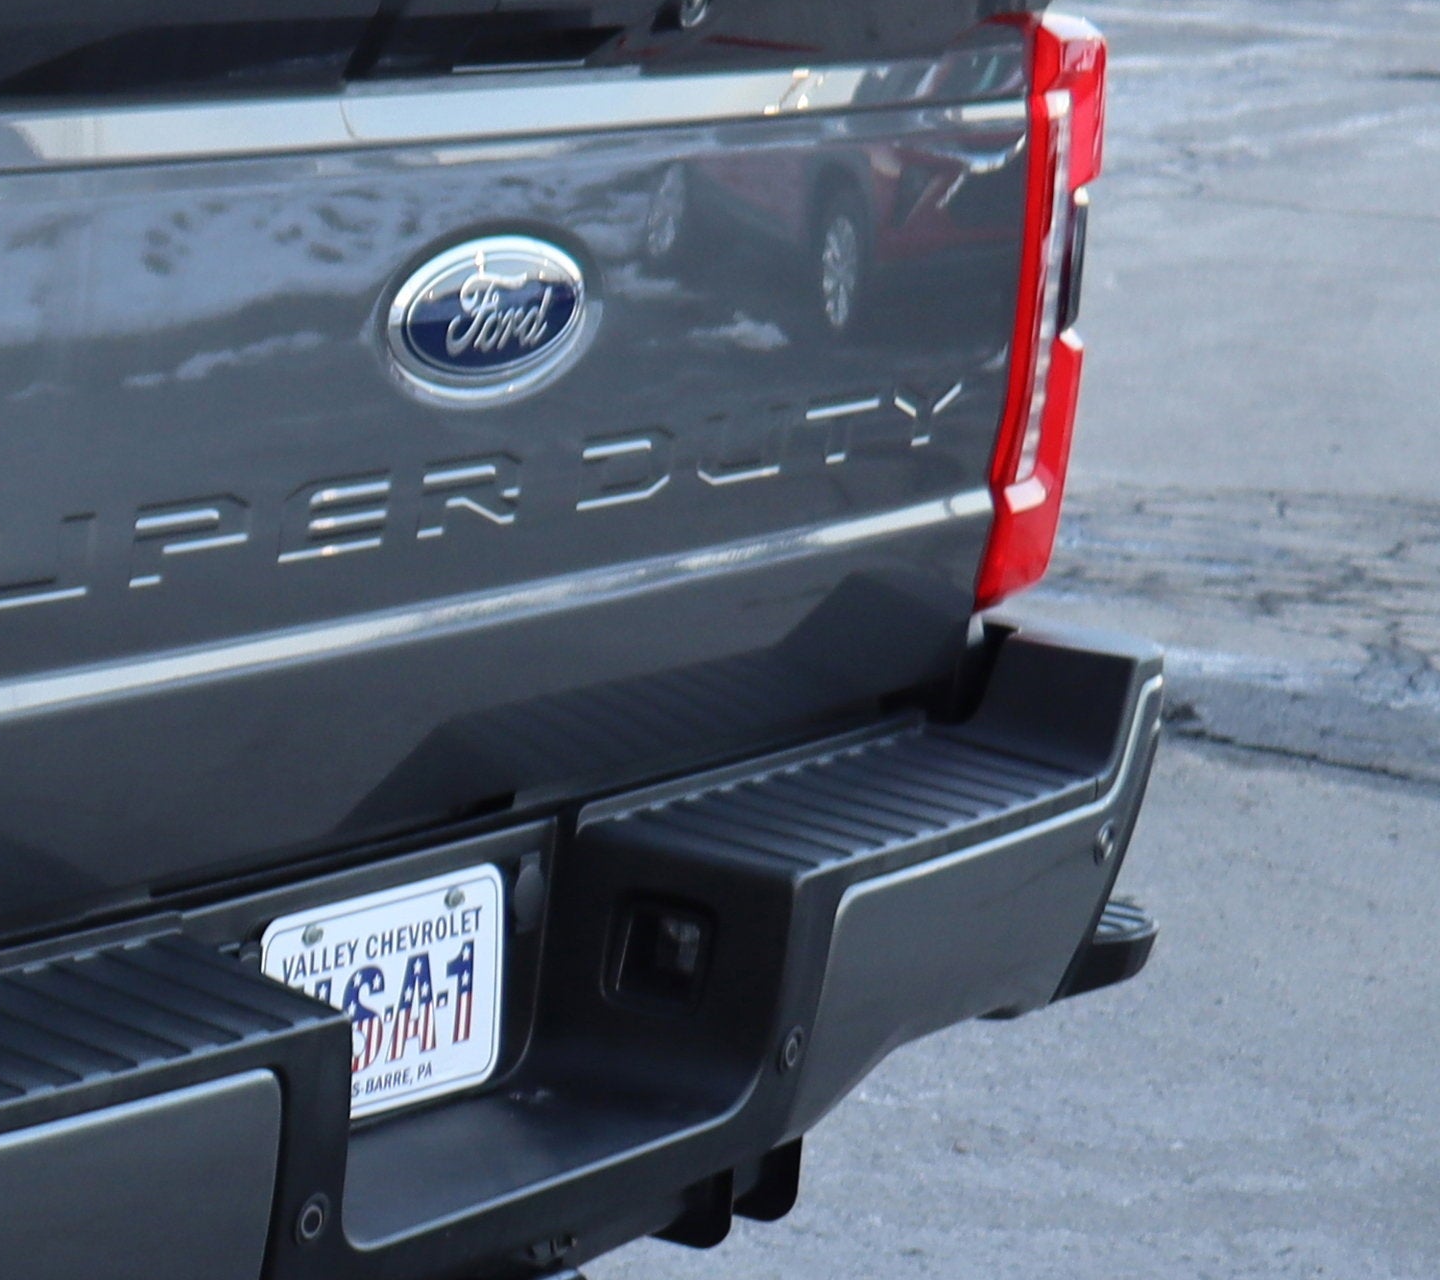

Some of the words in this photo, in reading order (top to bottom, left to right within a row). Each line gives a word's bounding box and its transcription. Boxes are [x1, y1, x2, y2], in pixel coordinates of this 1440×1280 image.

[446, 271, 552, 358] Ford
[576, 380, 965, 513] DUTY
[283, 939, 358, 985] VALLEY
[365, 907, 482, 959] CHEVROLET
[416, 1061, 432, 1081] PA
